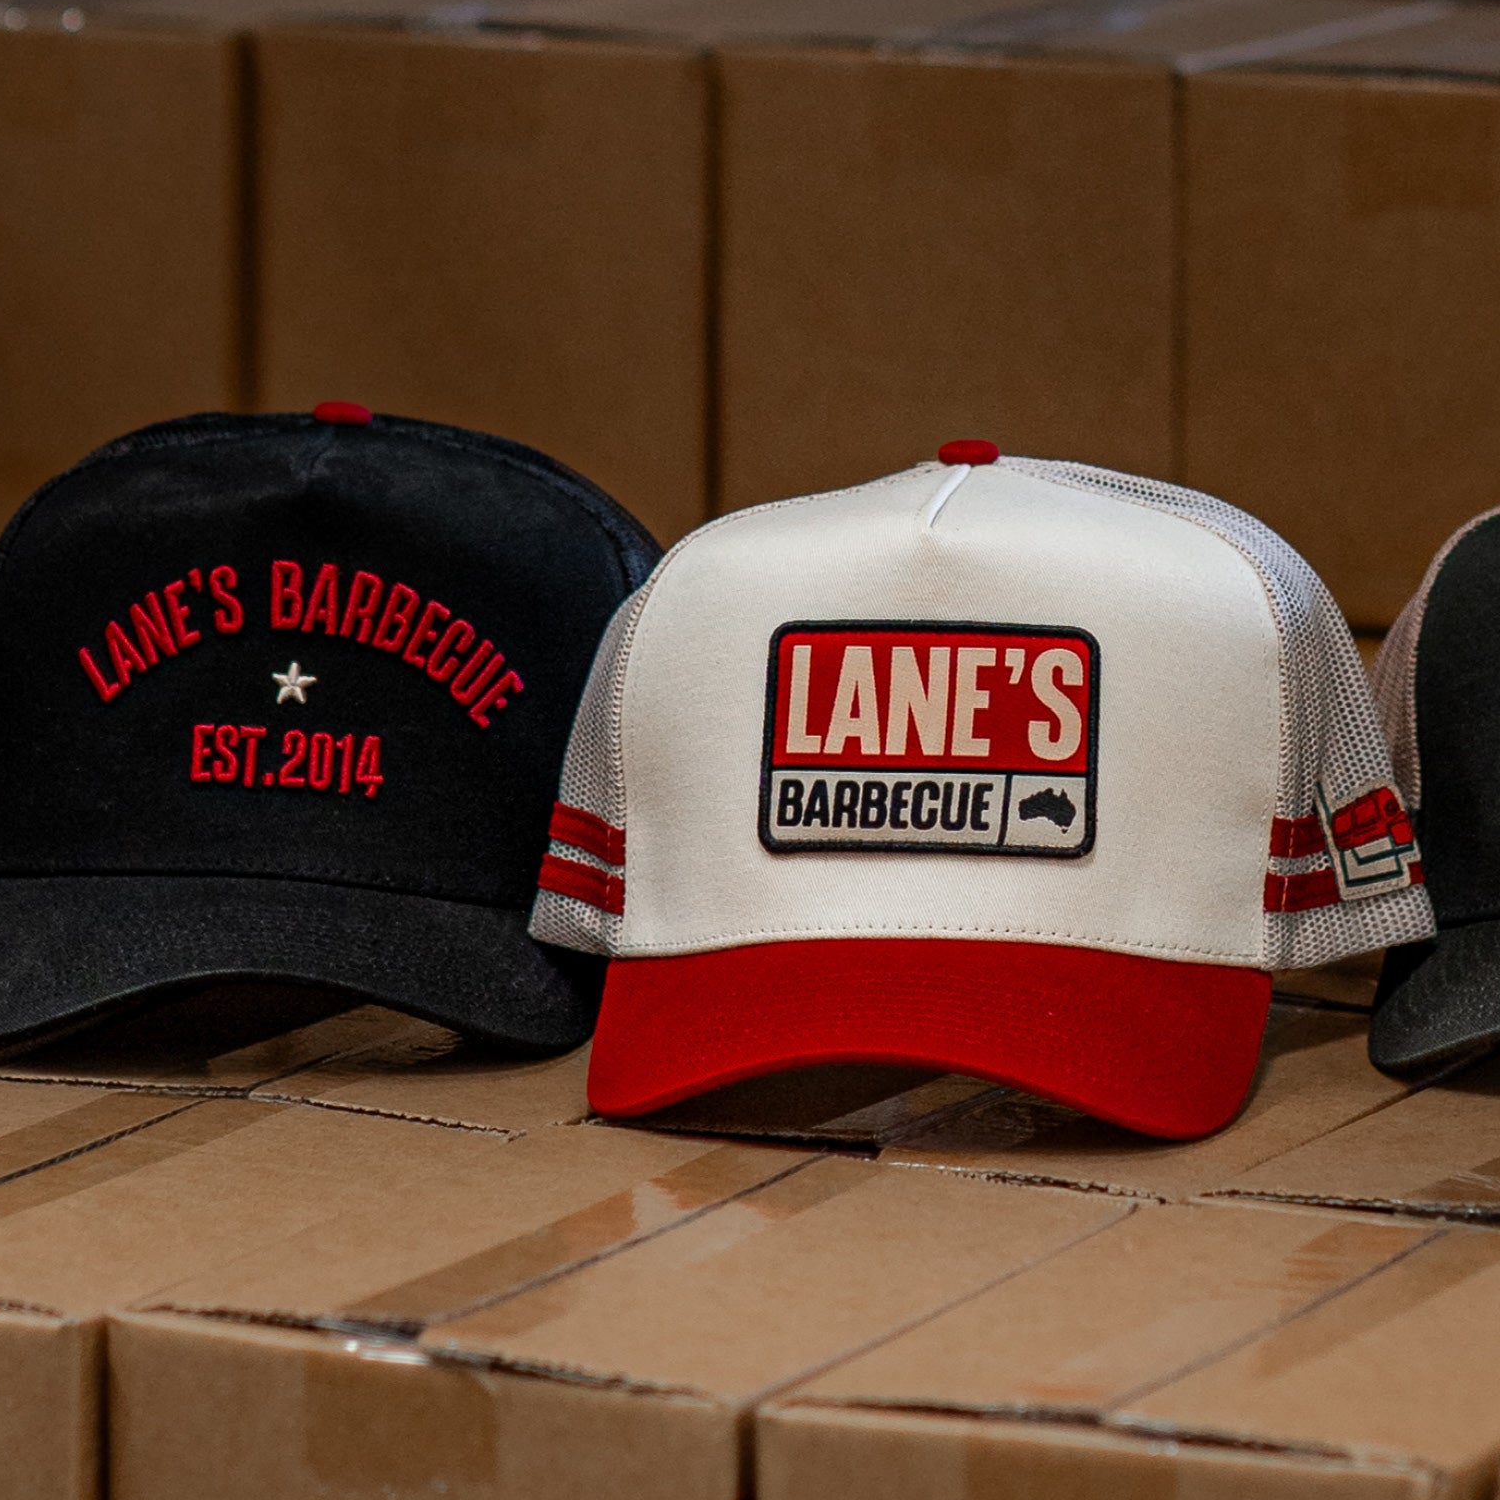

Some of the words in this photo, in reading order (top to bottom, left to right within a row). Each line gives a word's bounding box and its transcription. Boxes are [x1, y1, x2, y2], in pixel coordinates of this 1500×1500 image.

[78, 563, 245, 702] LANE'S
[270, 560, 525, 729] BARBECUE
[784, 644, 1085, 762] LANE'S
[776, 779, 993, 833] BARBECUE
